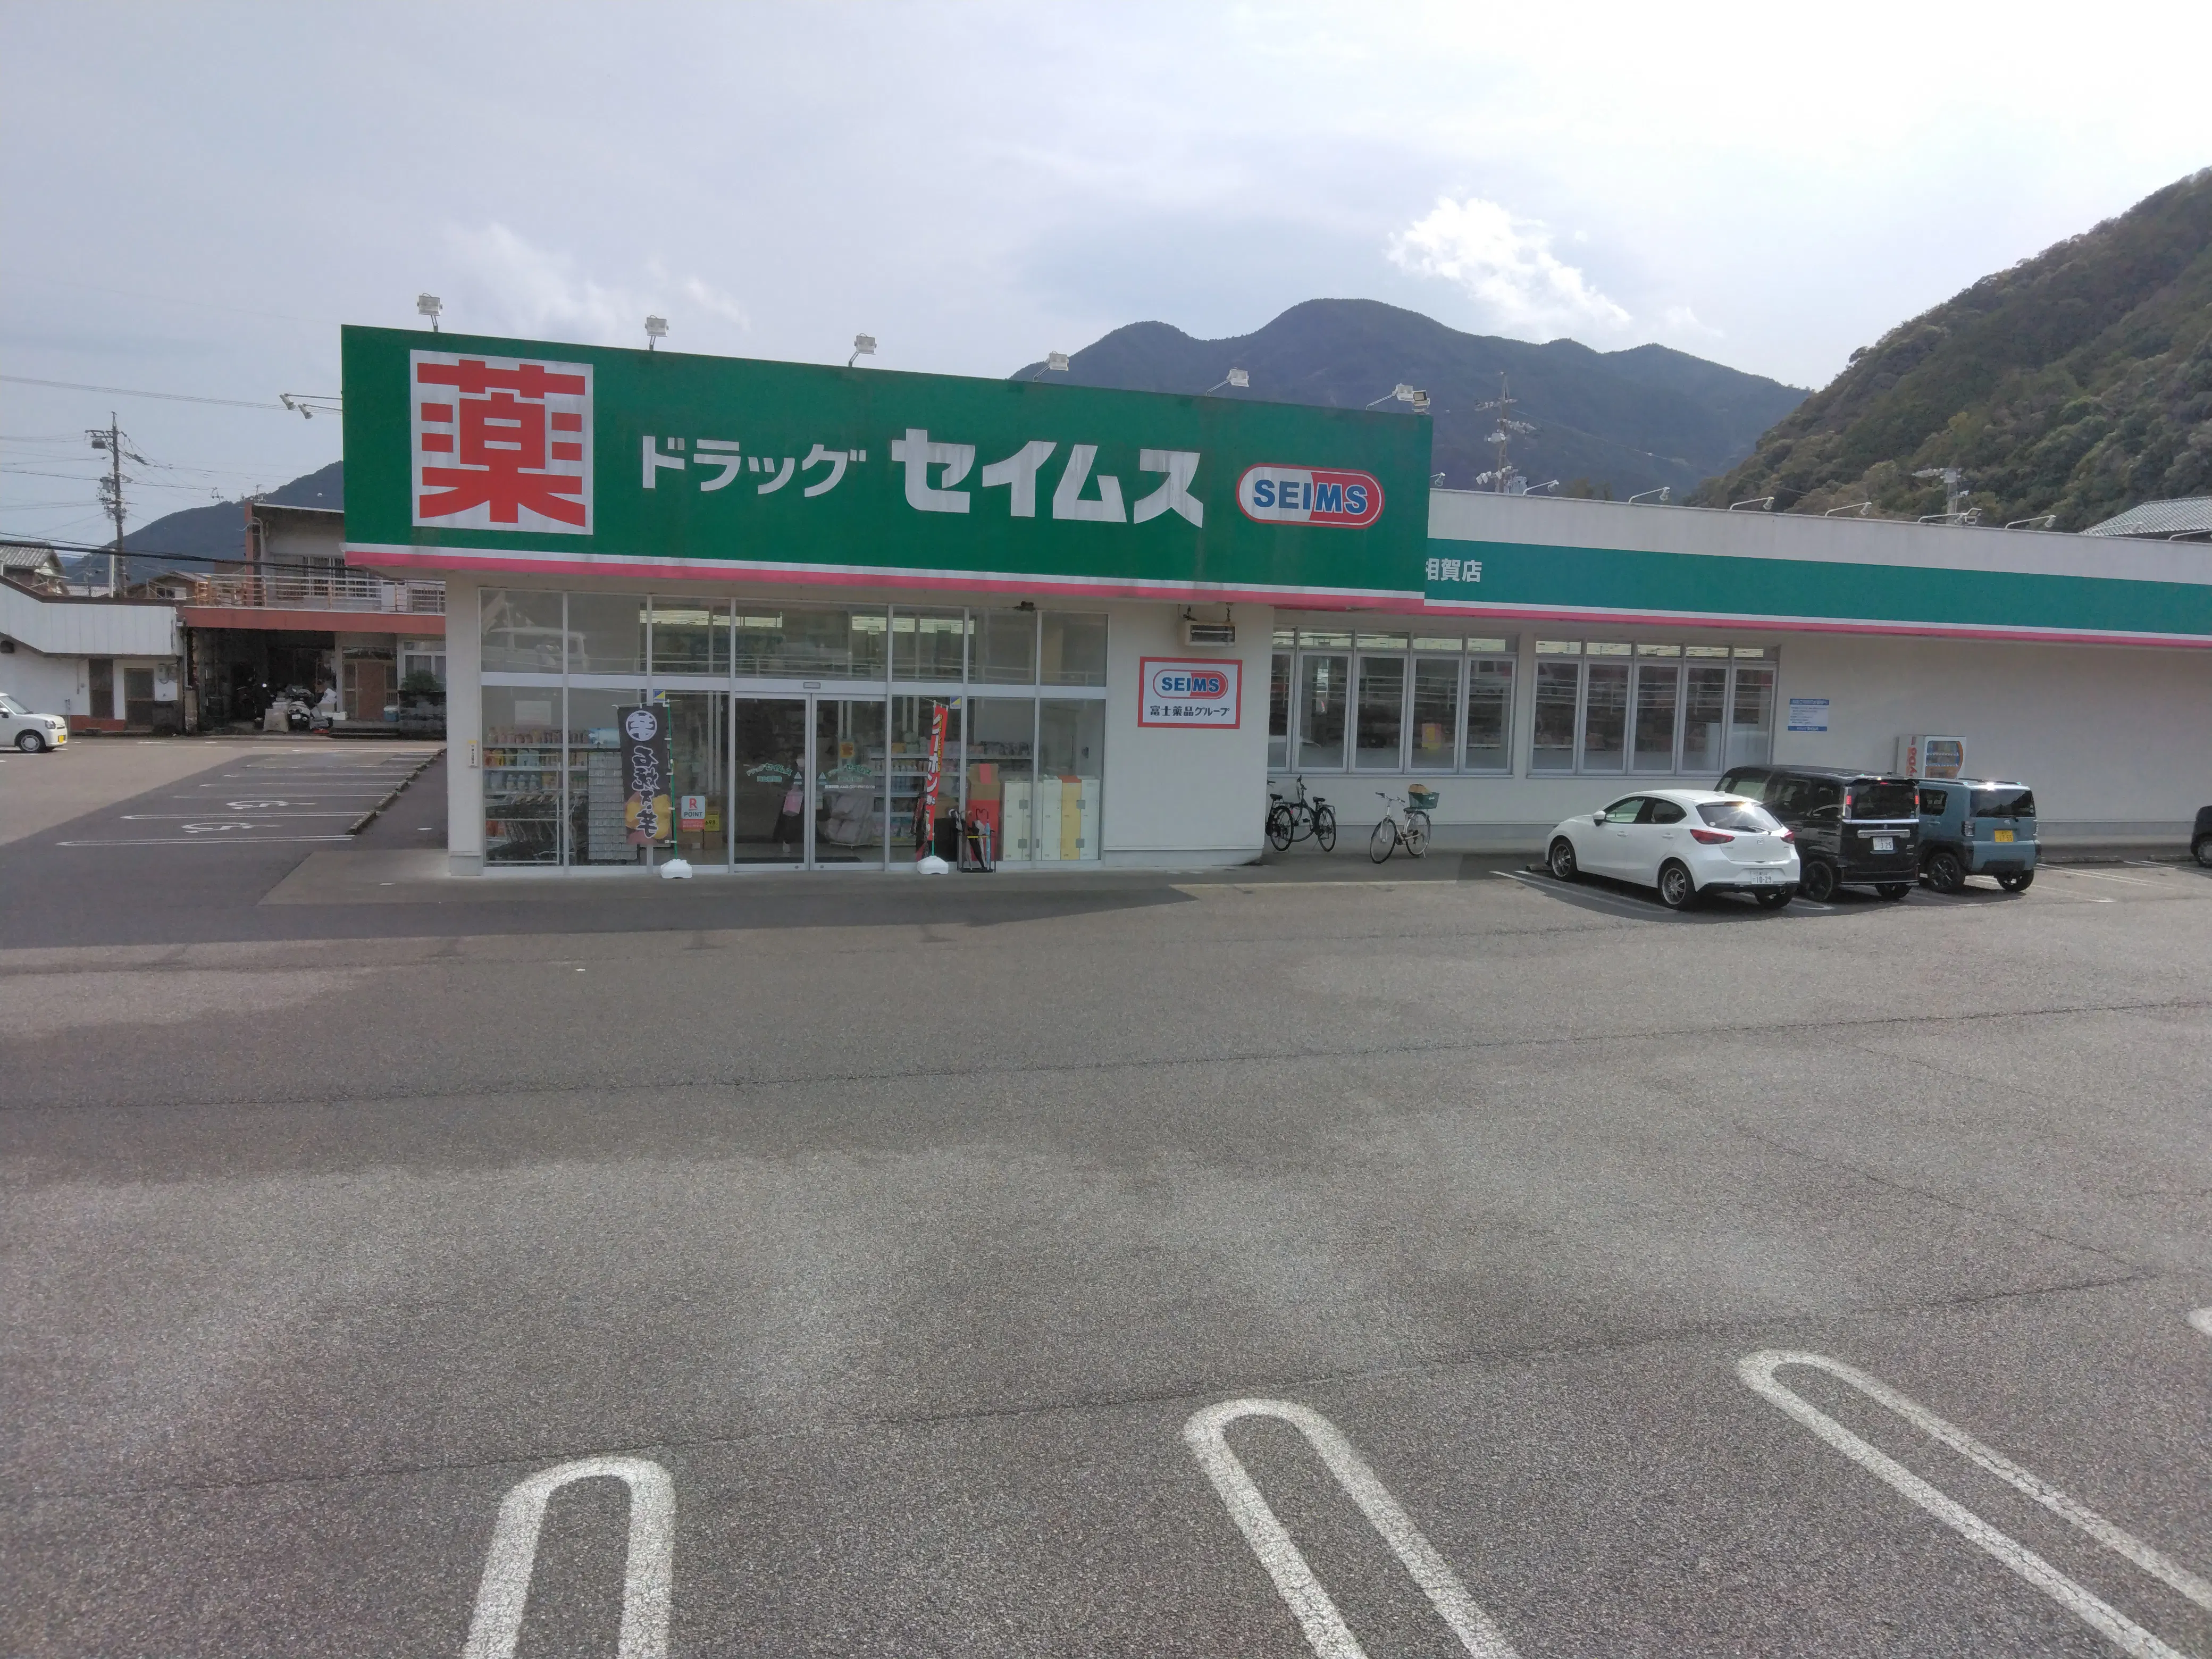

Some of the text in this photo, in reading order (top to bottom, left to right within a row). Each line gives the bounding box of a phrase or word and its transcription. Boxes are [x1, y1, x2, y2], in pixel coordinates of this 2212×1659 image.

[417, 359, 585, 527] 薬
[642, 428, 1203, 529] ドラッグ セイムス
[1252, 479, 1369, 516] SEIMS
[1161, 677, 1220, 692] SEIMS
[1150, 705, 1230, 717] 富士薬品グループ
[689, 798, 698, 809] R
